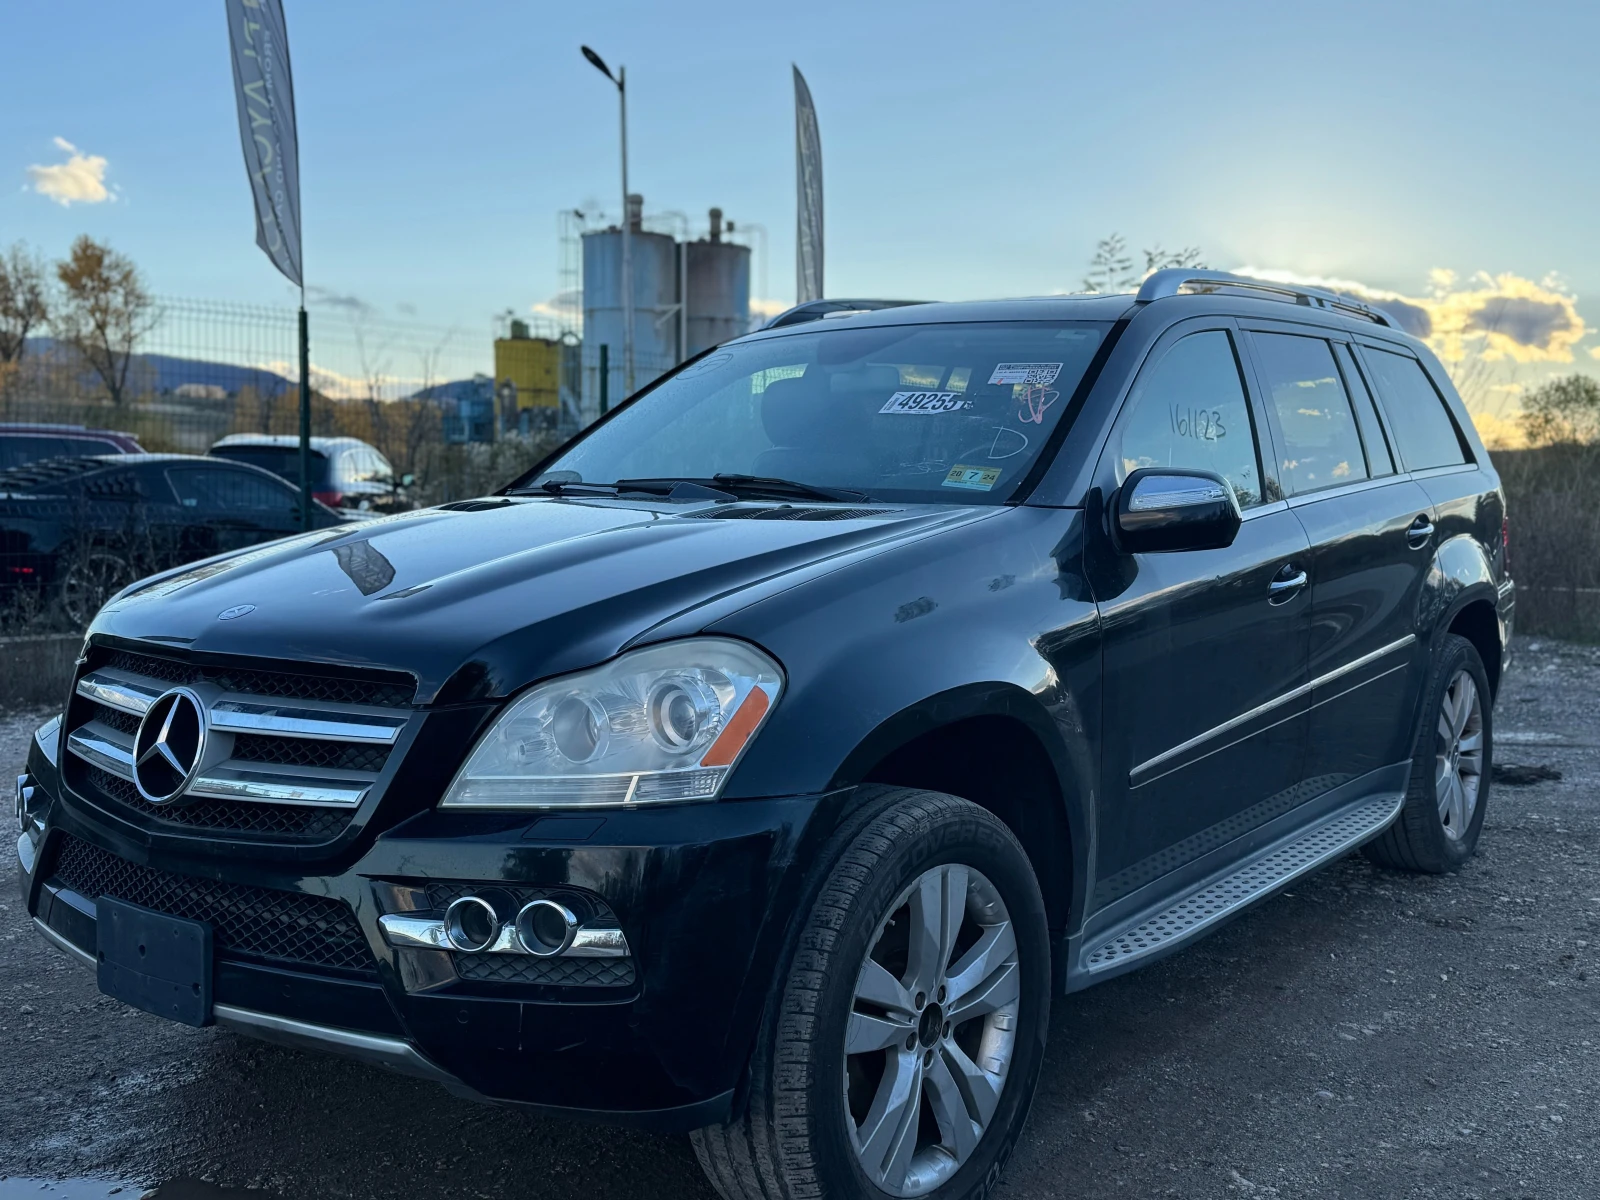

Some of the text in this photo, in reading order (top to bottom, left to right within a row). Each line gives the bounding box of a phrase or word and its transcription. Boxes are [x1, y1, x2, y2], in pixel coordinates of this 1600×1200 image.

[898, 393, 961, 411] 49255
[950, 470, 963, 478] 20
[968, 471, 979, 480] 7
